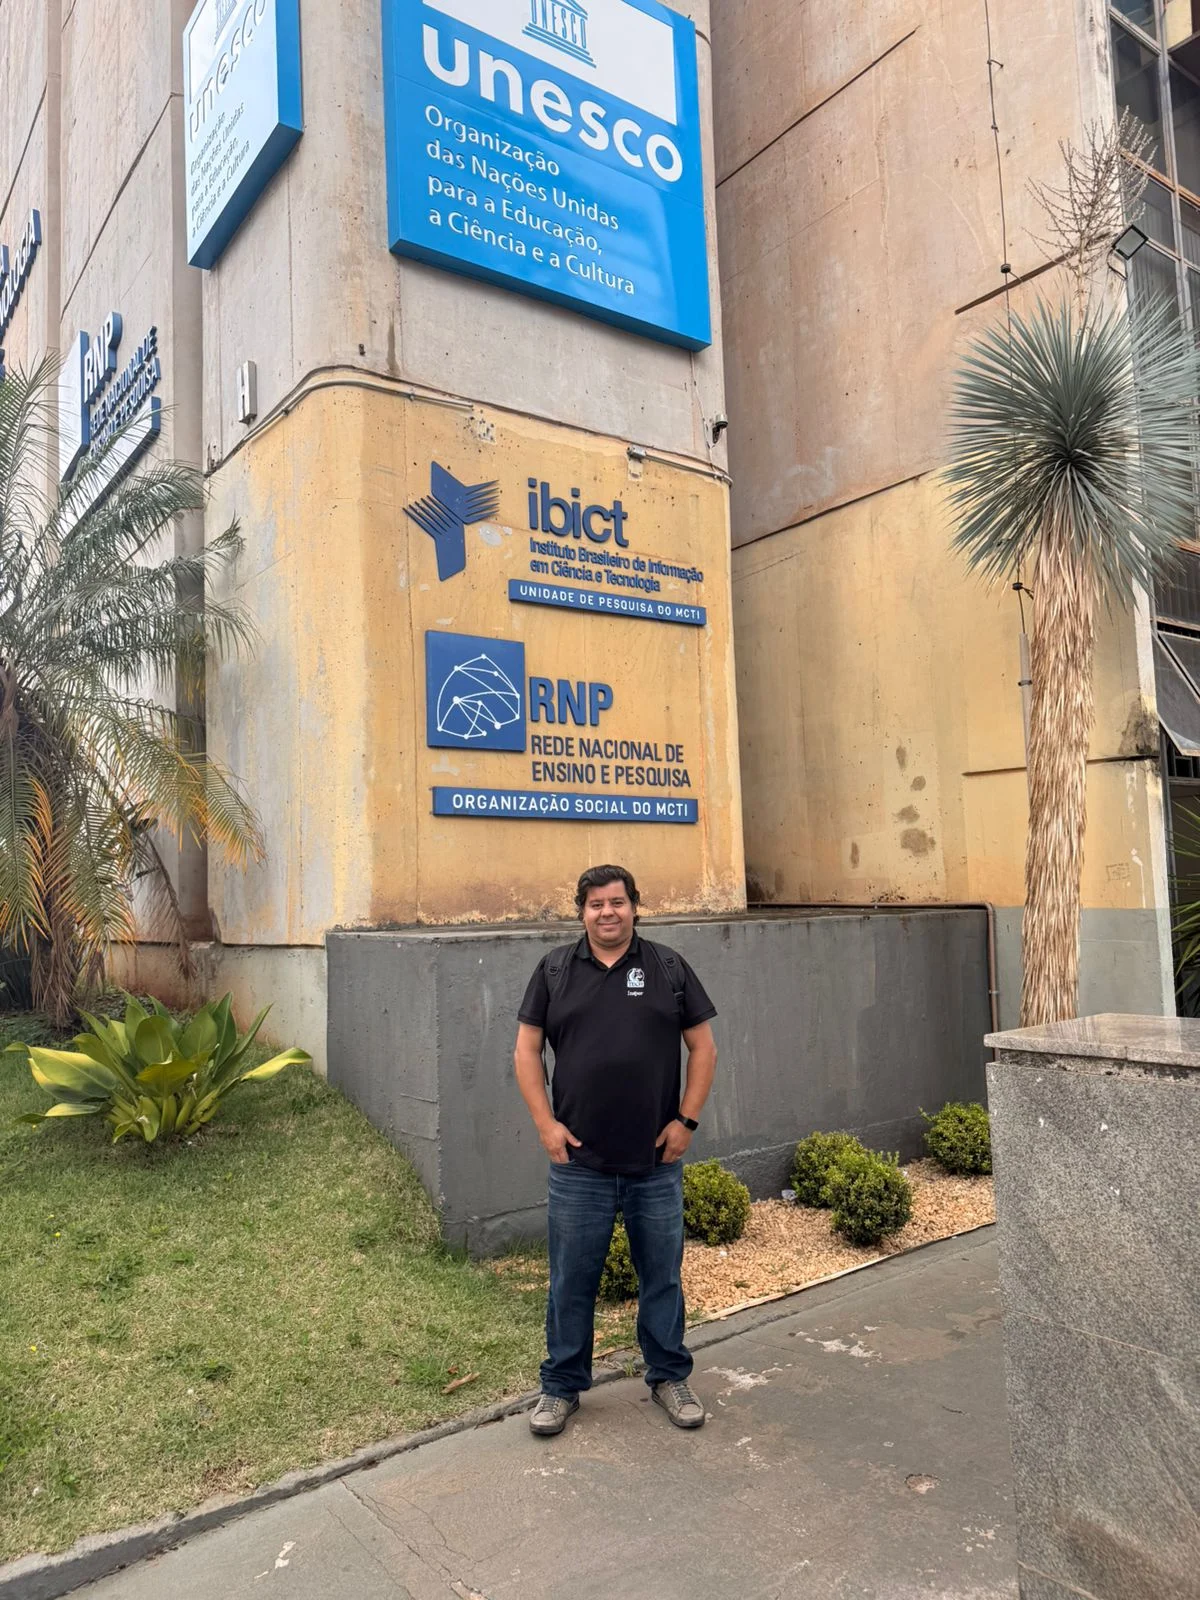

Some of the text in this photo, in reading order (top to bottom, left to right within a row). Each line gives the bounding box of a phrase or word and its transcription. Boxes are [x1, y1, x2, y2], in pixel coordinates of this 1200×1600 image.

[190, 0, 266, 143] unesco
[223, 102, 244, 143] Unidas
[422, 23, 683, 183] unesco
[227, 140, 249, 182] Cultura
[425, 104, 560, 177] Organização
[426, 139, 619, 231] das Nações Unidas
[428, 174, 603, 255] para a Educação,
[429, 208, 635, 295] a Ciência e a Cultura
[84, 311, 122, 404] RNP
[527, 477, 629, 547] ibict
[530, 537, 704, 583] Instituto Brasileiro de Informação
[530, 559, 660, 593] em Ciência e Tecnologia
[520, 585, 700, 620] UNIDADE DE PESQUISA DO MCTI
[529, 676, 614, 726] RNP
[531, 735, 684, 763] REDE NACIONAL DE
[532, 762, 691, 788] ENSINO E PESQUISA
[452, 792, 689, 816] ORGANIZAÇÃO SOCIAL DO MCTI
